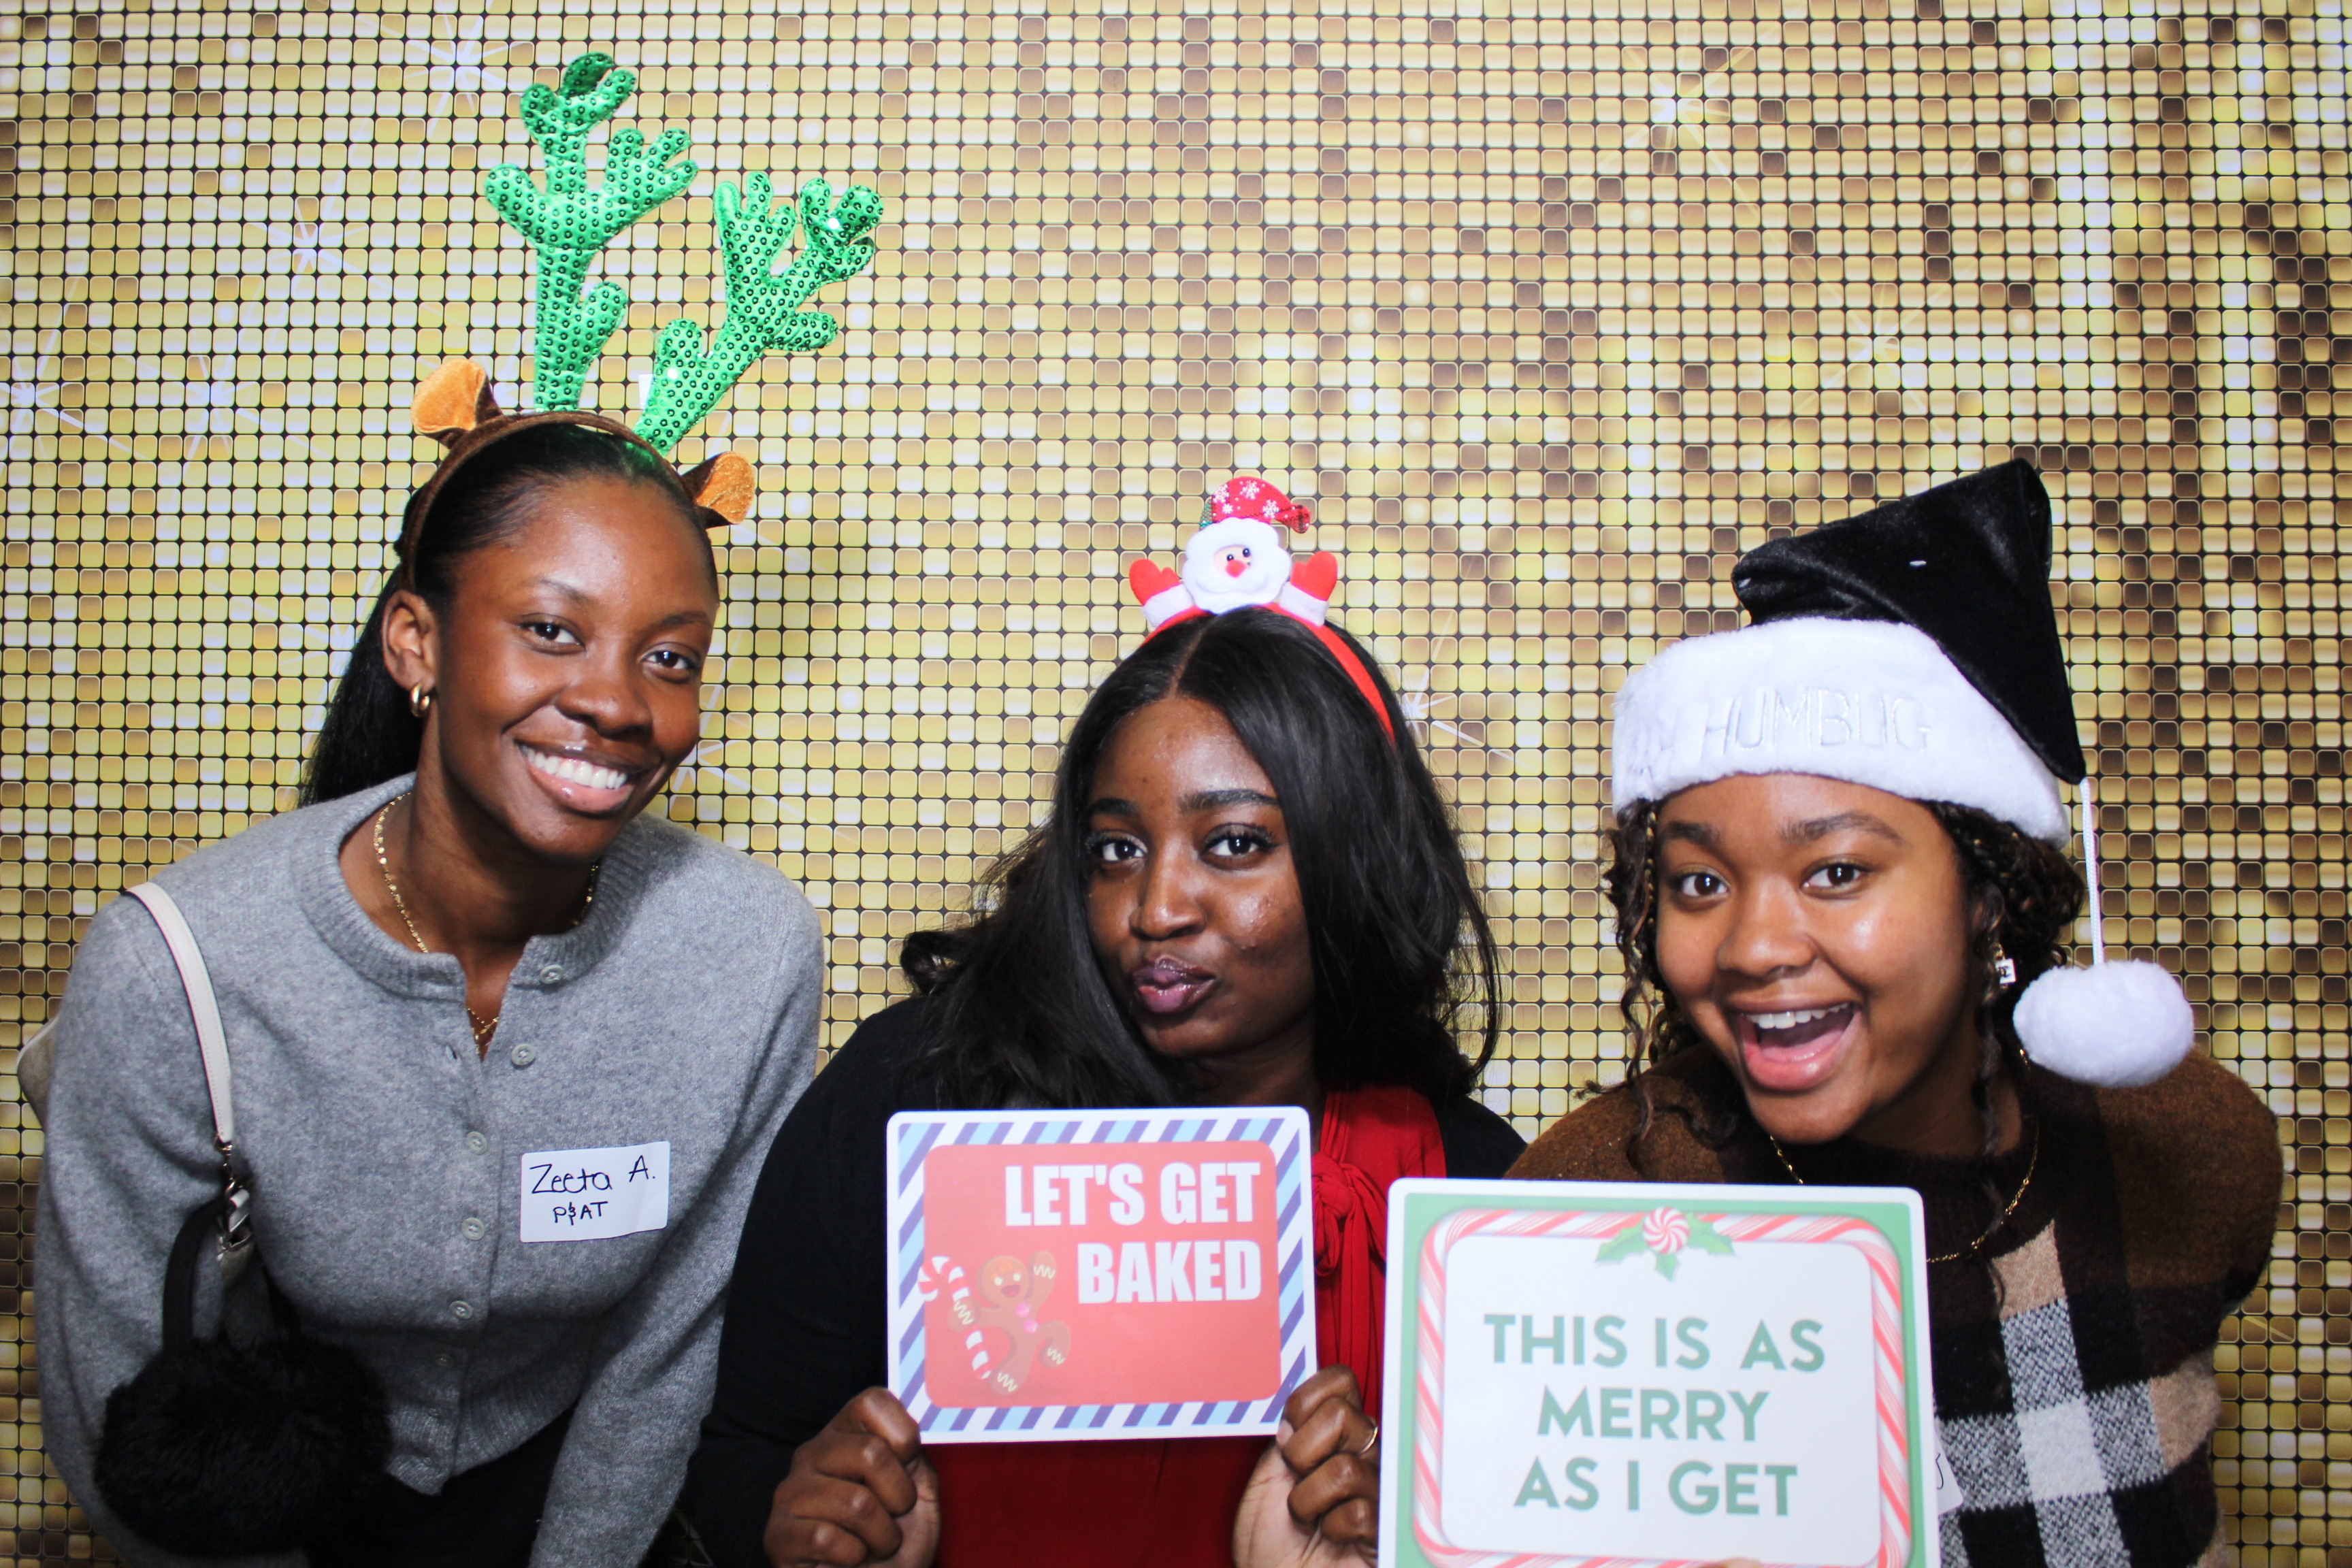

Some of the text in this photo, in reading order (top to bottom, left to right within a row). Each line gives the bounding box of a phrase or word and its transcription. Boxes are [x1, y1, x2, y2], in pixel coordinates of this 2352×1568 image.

[1701, 687, 1931, 755] HUMBUG
[529, 1155, 656, 1194] Zeeta A.
[1004, 1161, 1261, 1226] LET'S GET
[1077, 1239, 1262, 1304] BAKED
[1484, 1313, 1826, 1373] THIS IS AS
[1537, 1385, 1769, 1441] MERRY
[1513, 1455, 1799, 1517] AS I GET
